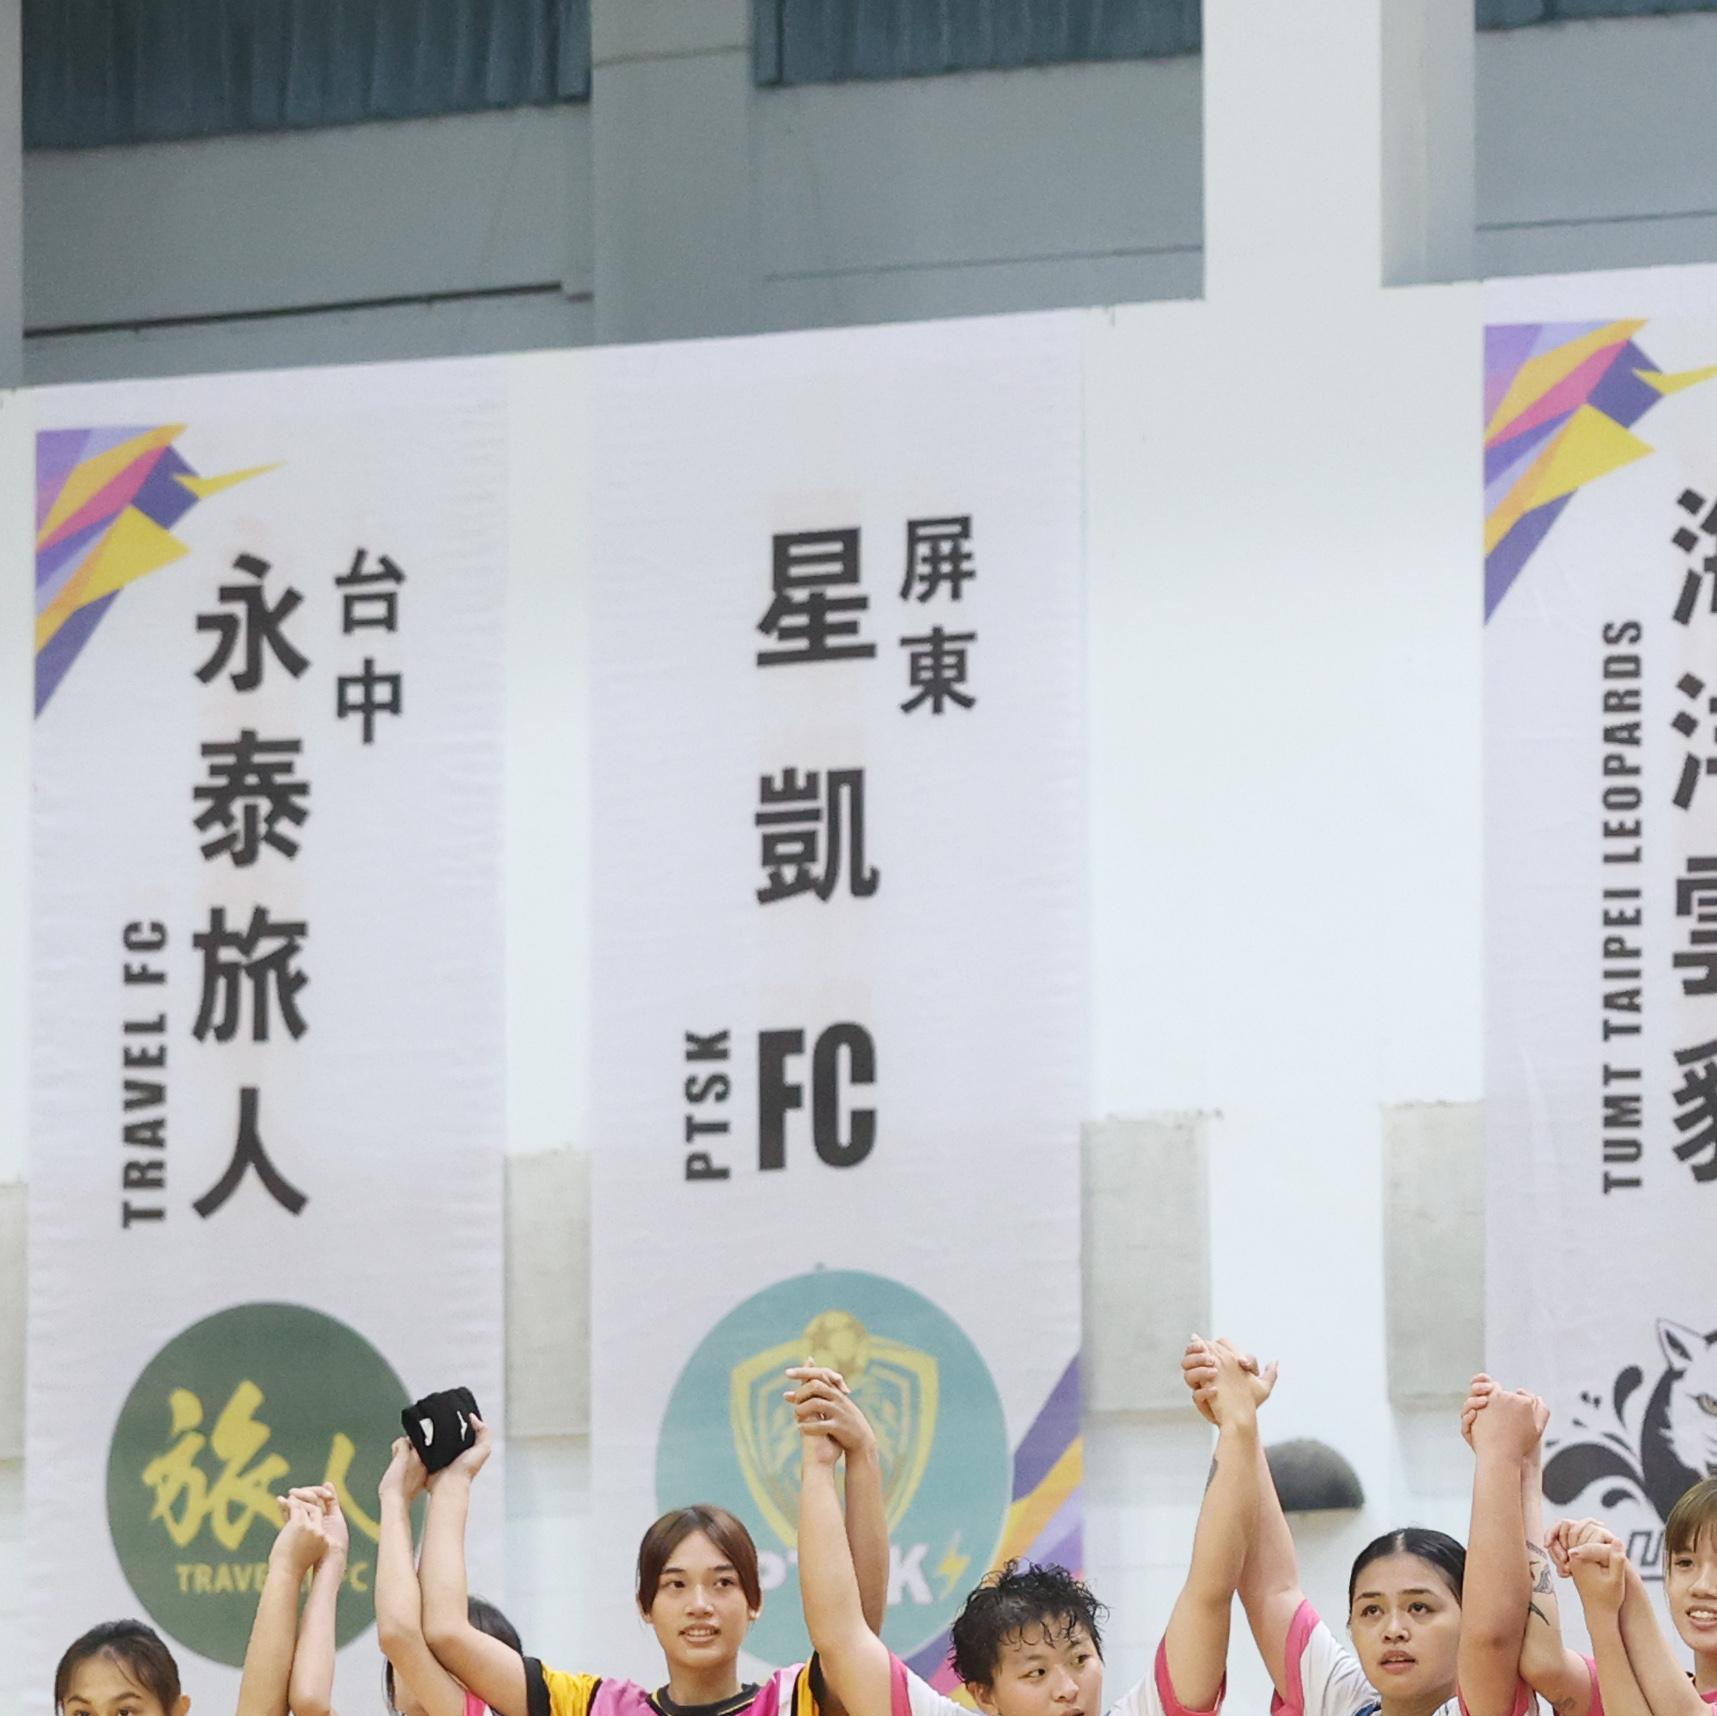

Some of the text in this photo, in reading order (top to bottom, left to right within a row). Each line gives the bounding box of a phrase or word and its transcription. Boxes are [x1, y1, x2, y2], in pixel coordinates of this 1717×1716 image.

[334, 548, 405, 744] 台中
[899, 515, 976, 715] 屏東
[192, 553, 310, 1219] 永泰旅人
[1602, 621, 1642, 1194] TUMT TAIPEI LEOPARDS
[122, 922, 166, 1228] TRAVEL FC
[684, 1030, 730, 1181] PTSK
